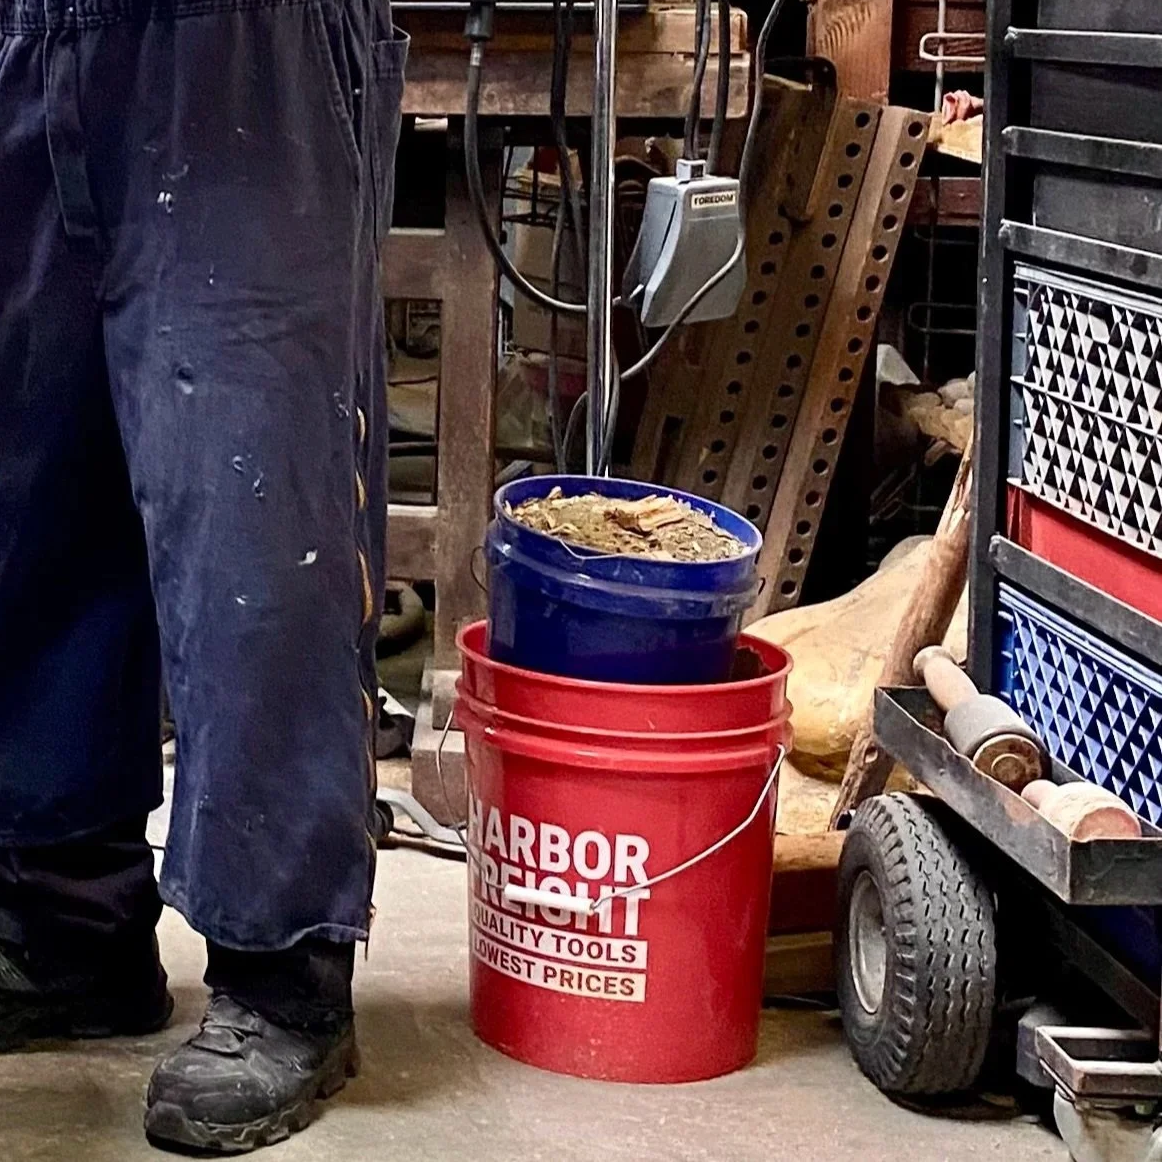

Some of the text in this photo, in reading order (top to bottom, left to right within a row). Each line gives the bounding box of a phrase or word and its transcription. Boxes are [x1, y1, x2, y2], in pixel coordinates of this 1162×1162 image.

[694, 193, 734, 205] FOREDOM
[468, 790, 650, 885] HARBOR
[474, 904, 637, 963] QUALITY TOOLS
[475, 938, 635, 997] LOWEST PRICES
